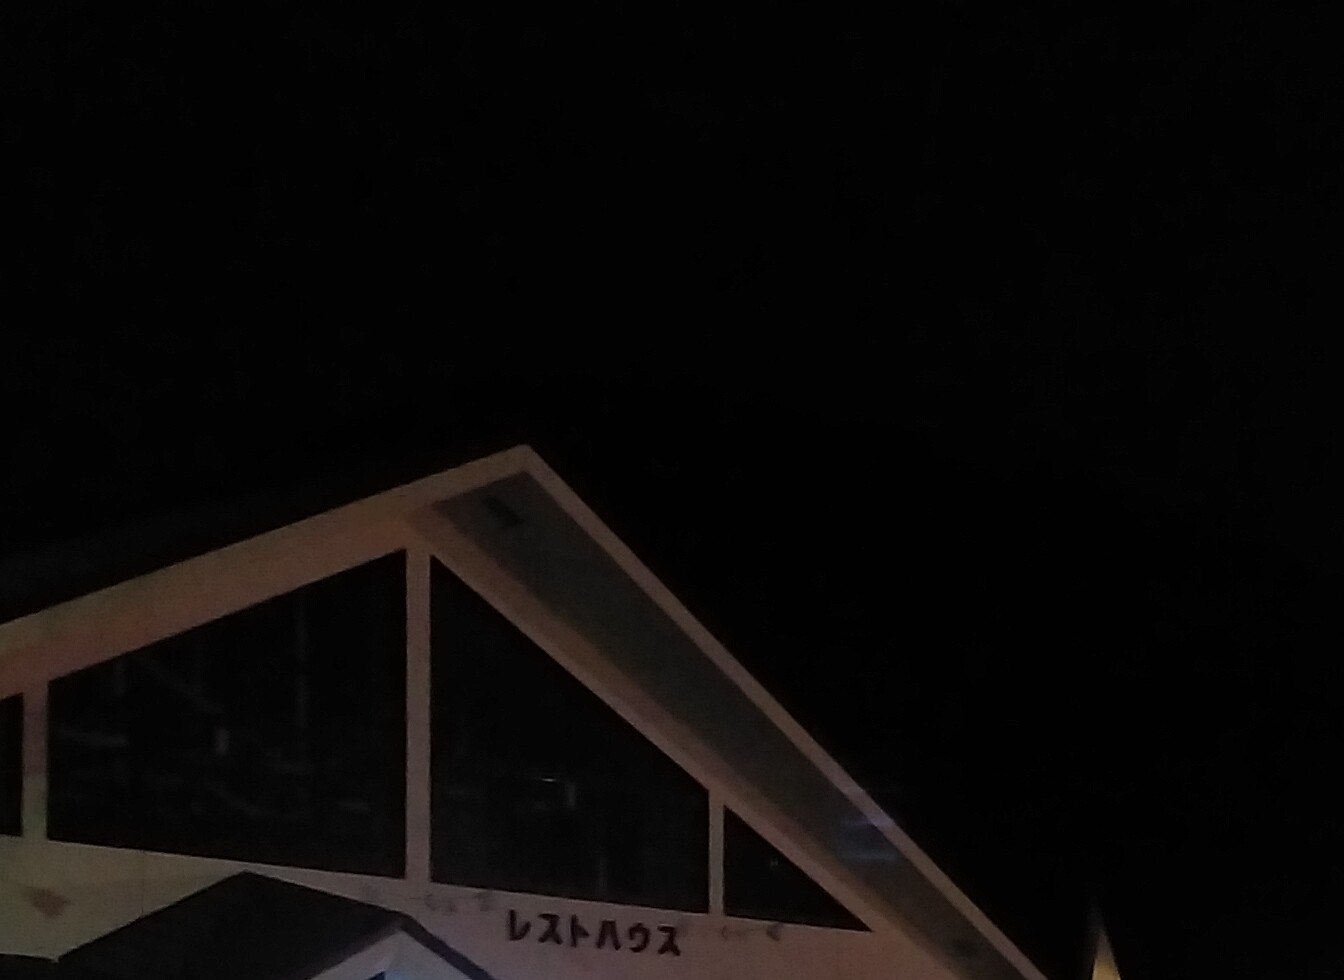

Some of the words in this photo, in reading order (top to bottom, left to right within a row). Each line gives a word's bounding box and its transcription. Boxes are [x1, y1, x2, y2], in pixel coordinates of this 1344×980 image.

[507, 909, 681, 956] レストハウス
